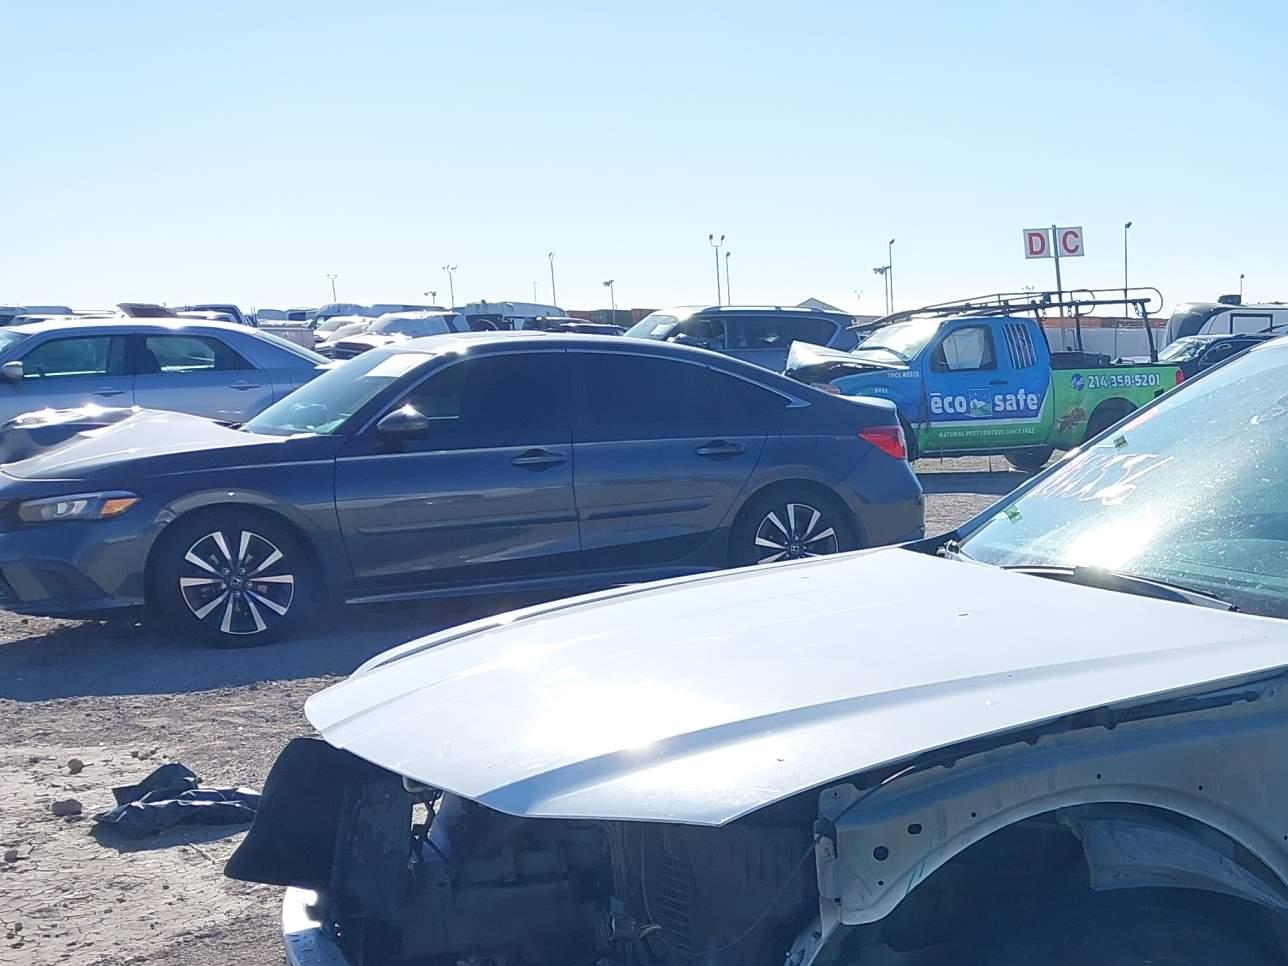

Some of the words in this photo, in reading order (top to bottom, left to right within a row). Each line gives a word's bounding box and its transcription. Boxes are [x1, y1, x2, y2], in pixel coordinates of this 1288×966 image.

[1028, 232, 1046, 256] D
[1062, 230, 1080, 254] C
[994, 388, 1038, 412] safe
